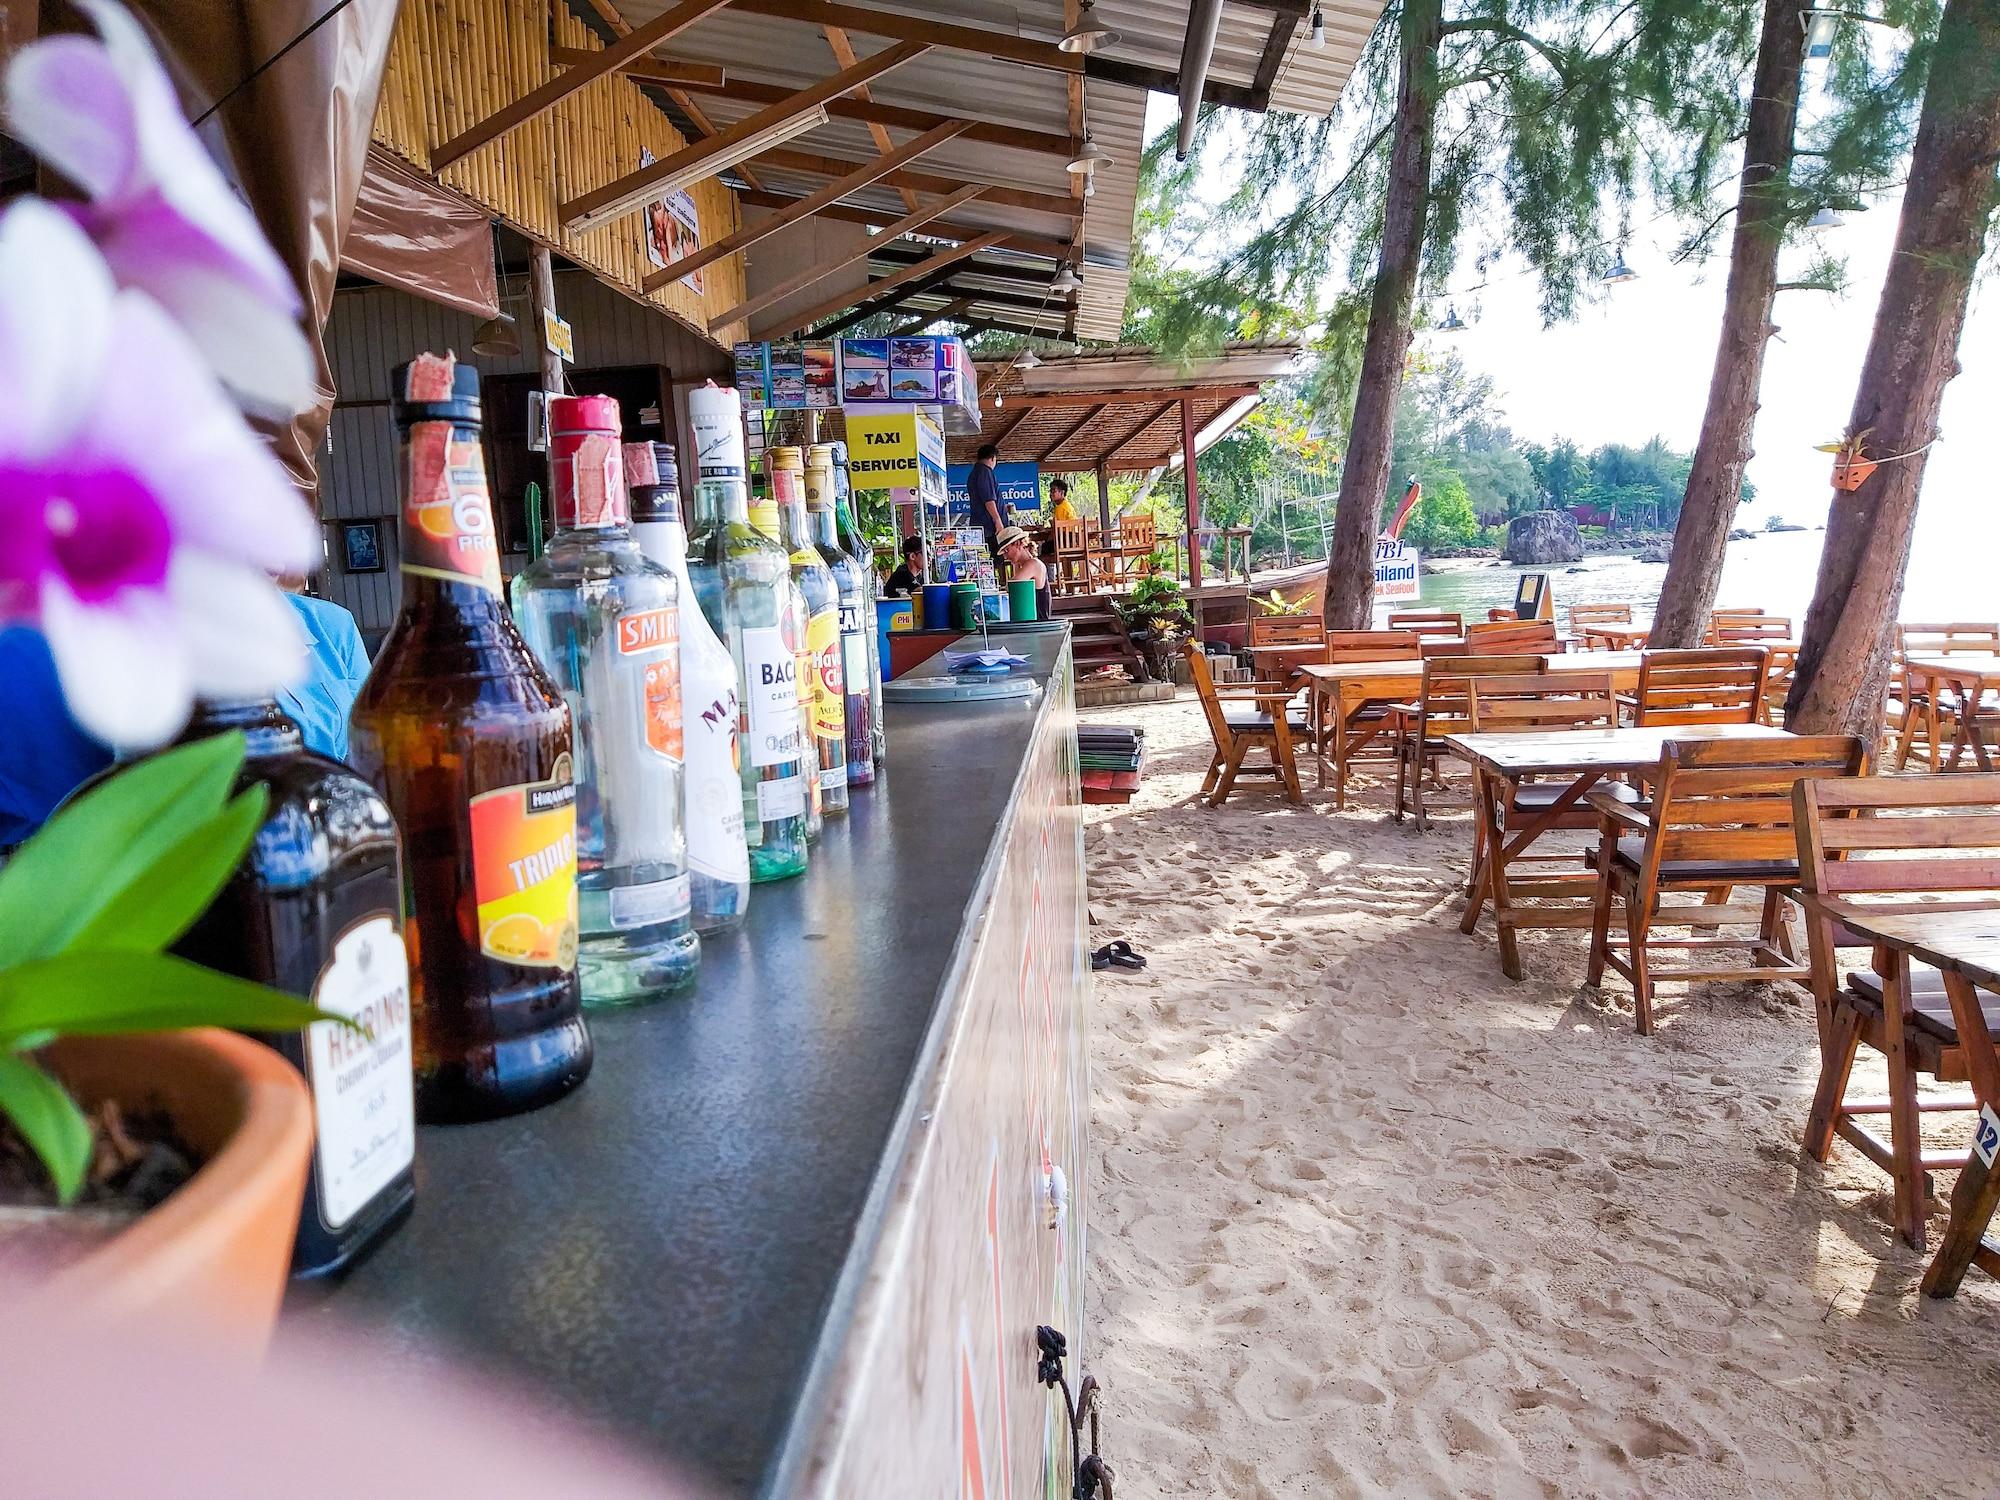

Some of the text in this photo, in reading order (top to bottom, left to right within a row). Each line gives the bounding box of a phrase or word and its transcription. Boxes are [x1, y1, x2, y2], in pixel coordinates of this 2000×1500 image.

[864, 432, 901, 445] TAXI
[850, 458, 918, 473] SERVICE
[1385, 582, 1416, 595] Seafood
[1976, 1118, 1998, 1158] 12
